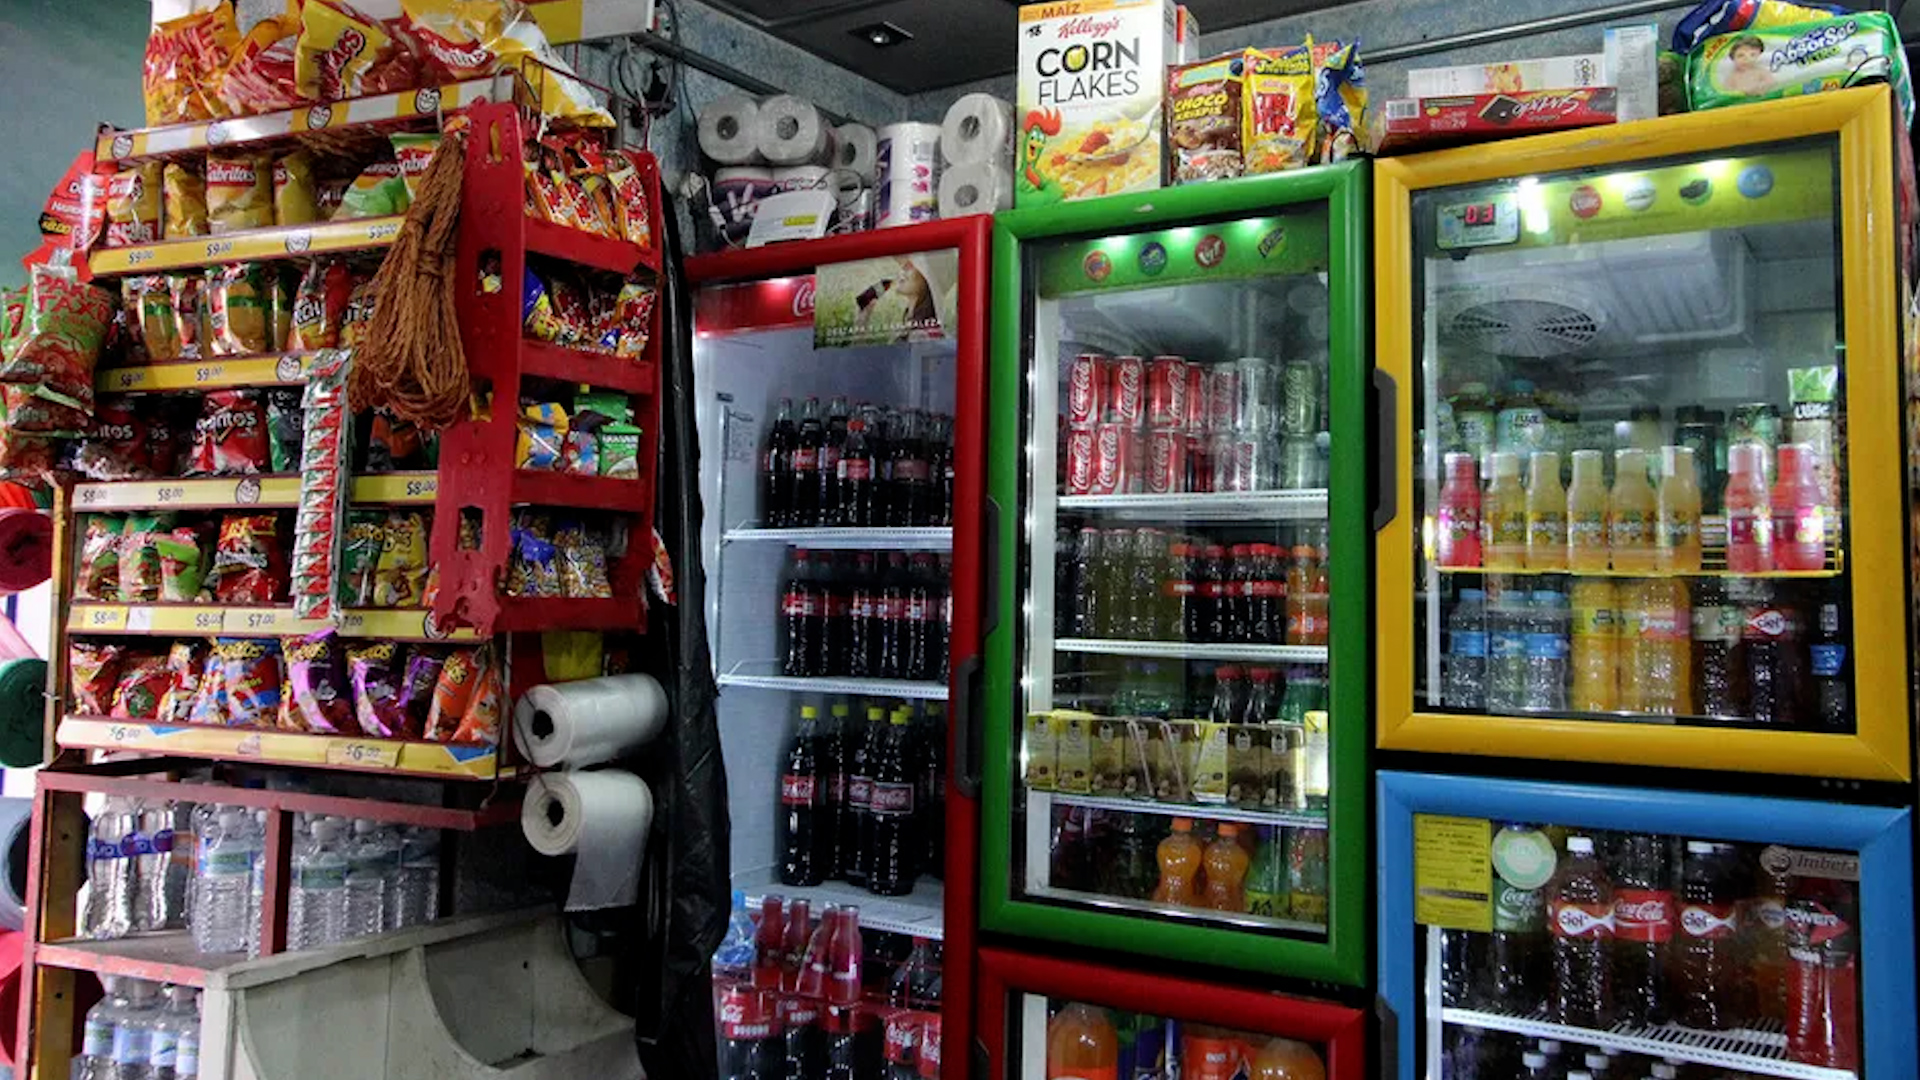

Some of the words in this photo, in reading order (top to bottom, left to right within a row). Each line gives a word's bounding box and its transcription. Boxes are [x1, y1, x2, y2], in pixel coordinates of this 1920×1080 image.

[1058, 16, 1120, 39] Kellogg's
[1036, 38, 1140, 77] CORN
[1038, 70, 1140, 105] FLAKES
[1174, 94, 1228, 113] CHOCO
[1615, 899, 1665, 922] Coca-Cola
